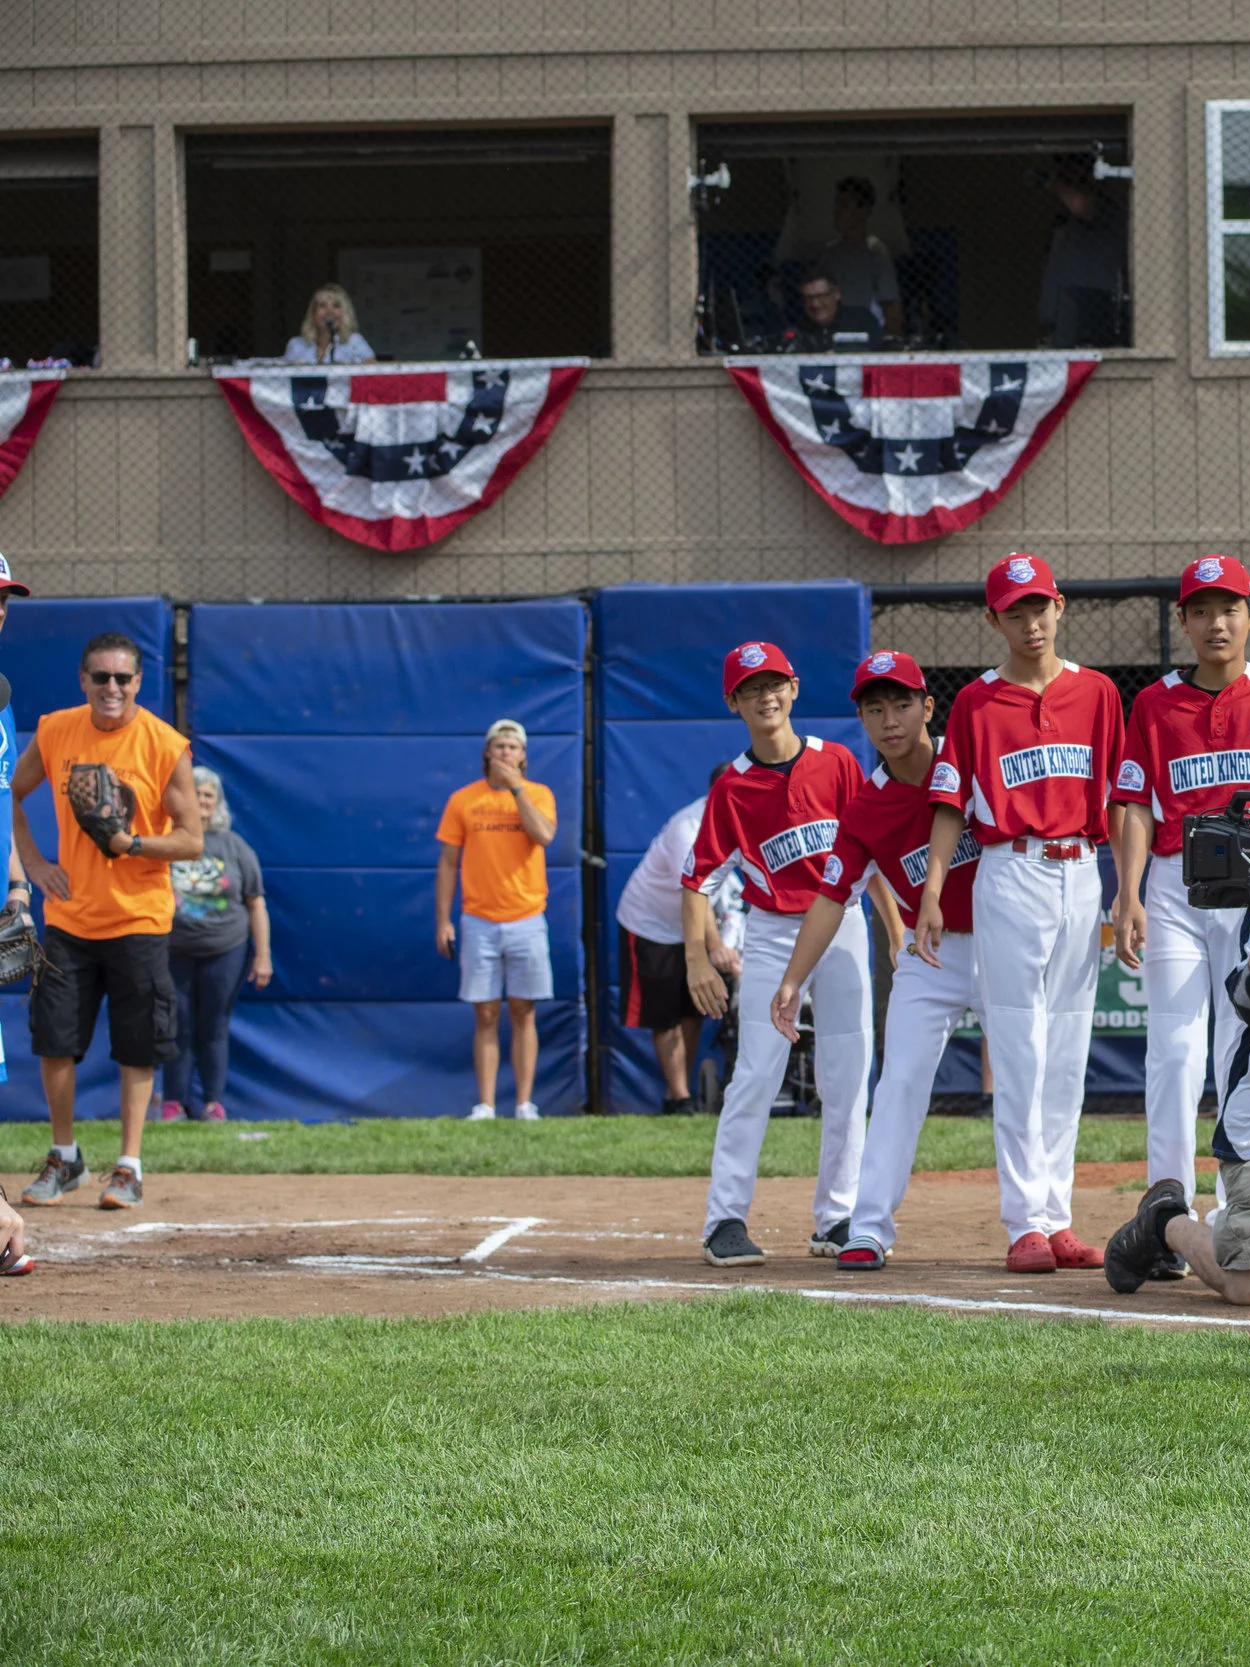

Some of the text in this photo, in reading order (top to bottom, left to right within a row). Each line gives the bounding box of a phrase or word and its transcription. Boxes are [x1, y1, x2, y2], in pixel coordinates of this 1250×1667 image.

[1002, 746, 1093, 785] UNITED KINGDOM
[1171, 755, 1214, 790] UNITED
[762, 821, 839, 870] UNITED KINGDO
[902, 844, 930, 884] UNIT
[1094, 1011, 1149, 1028] OODS
